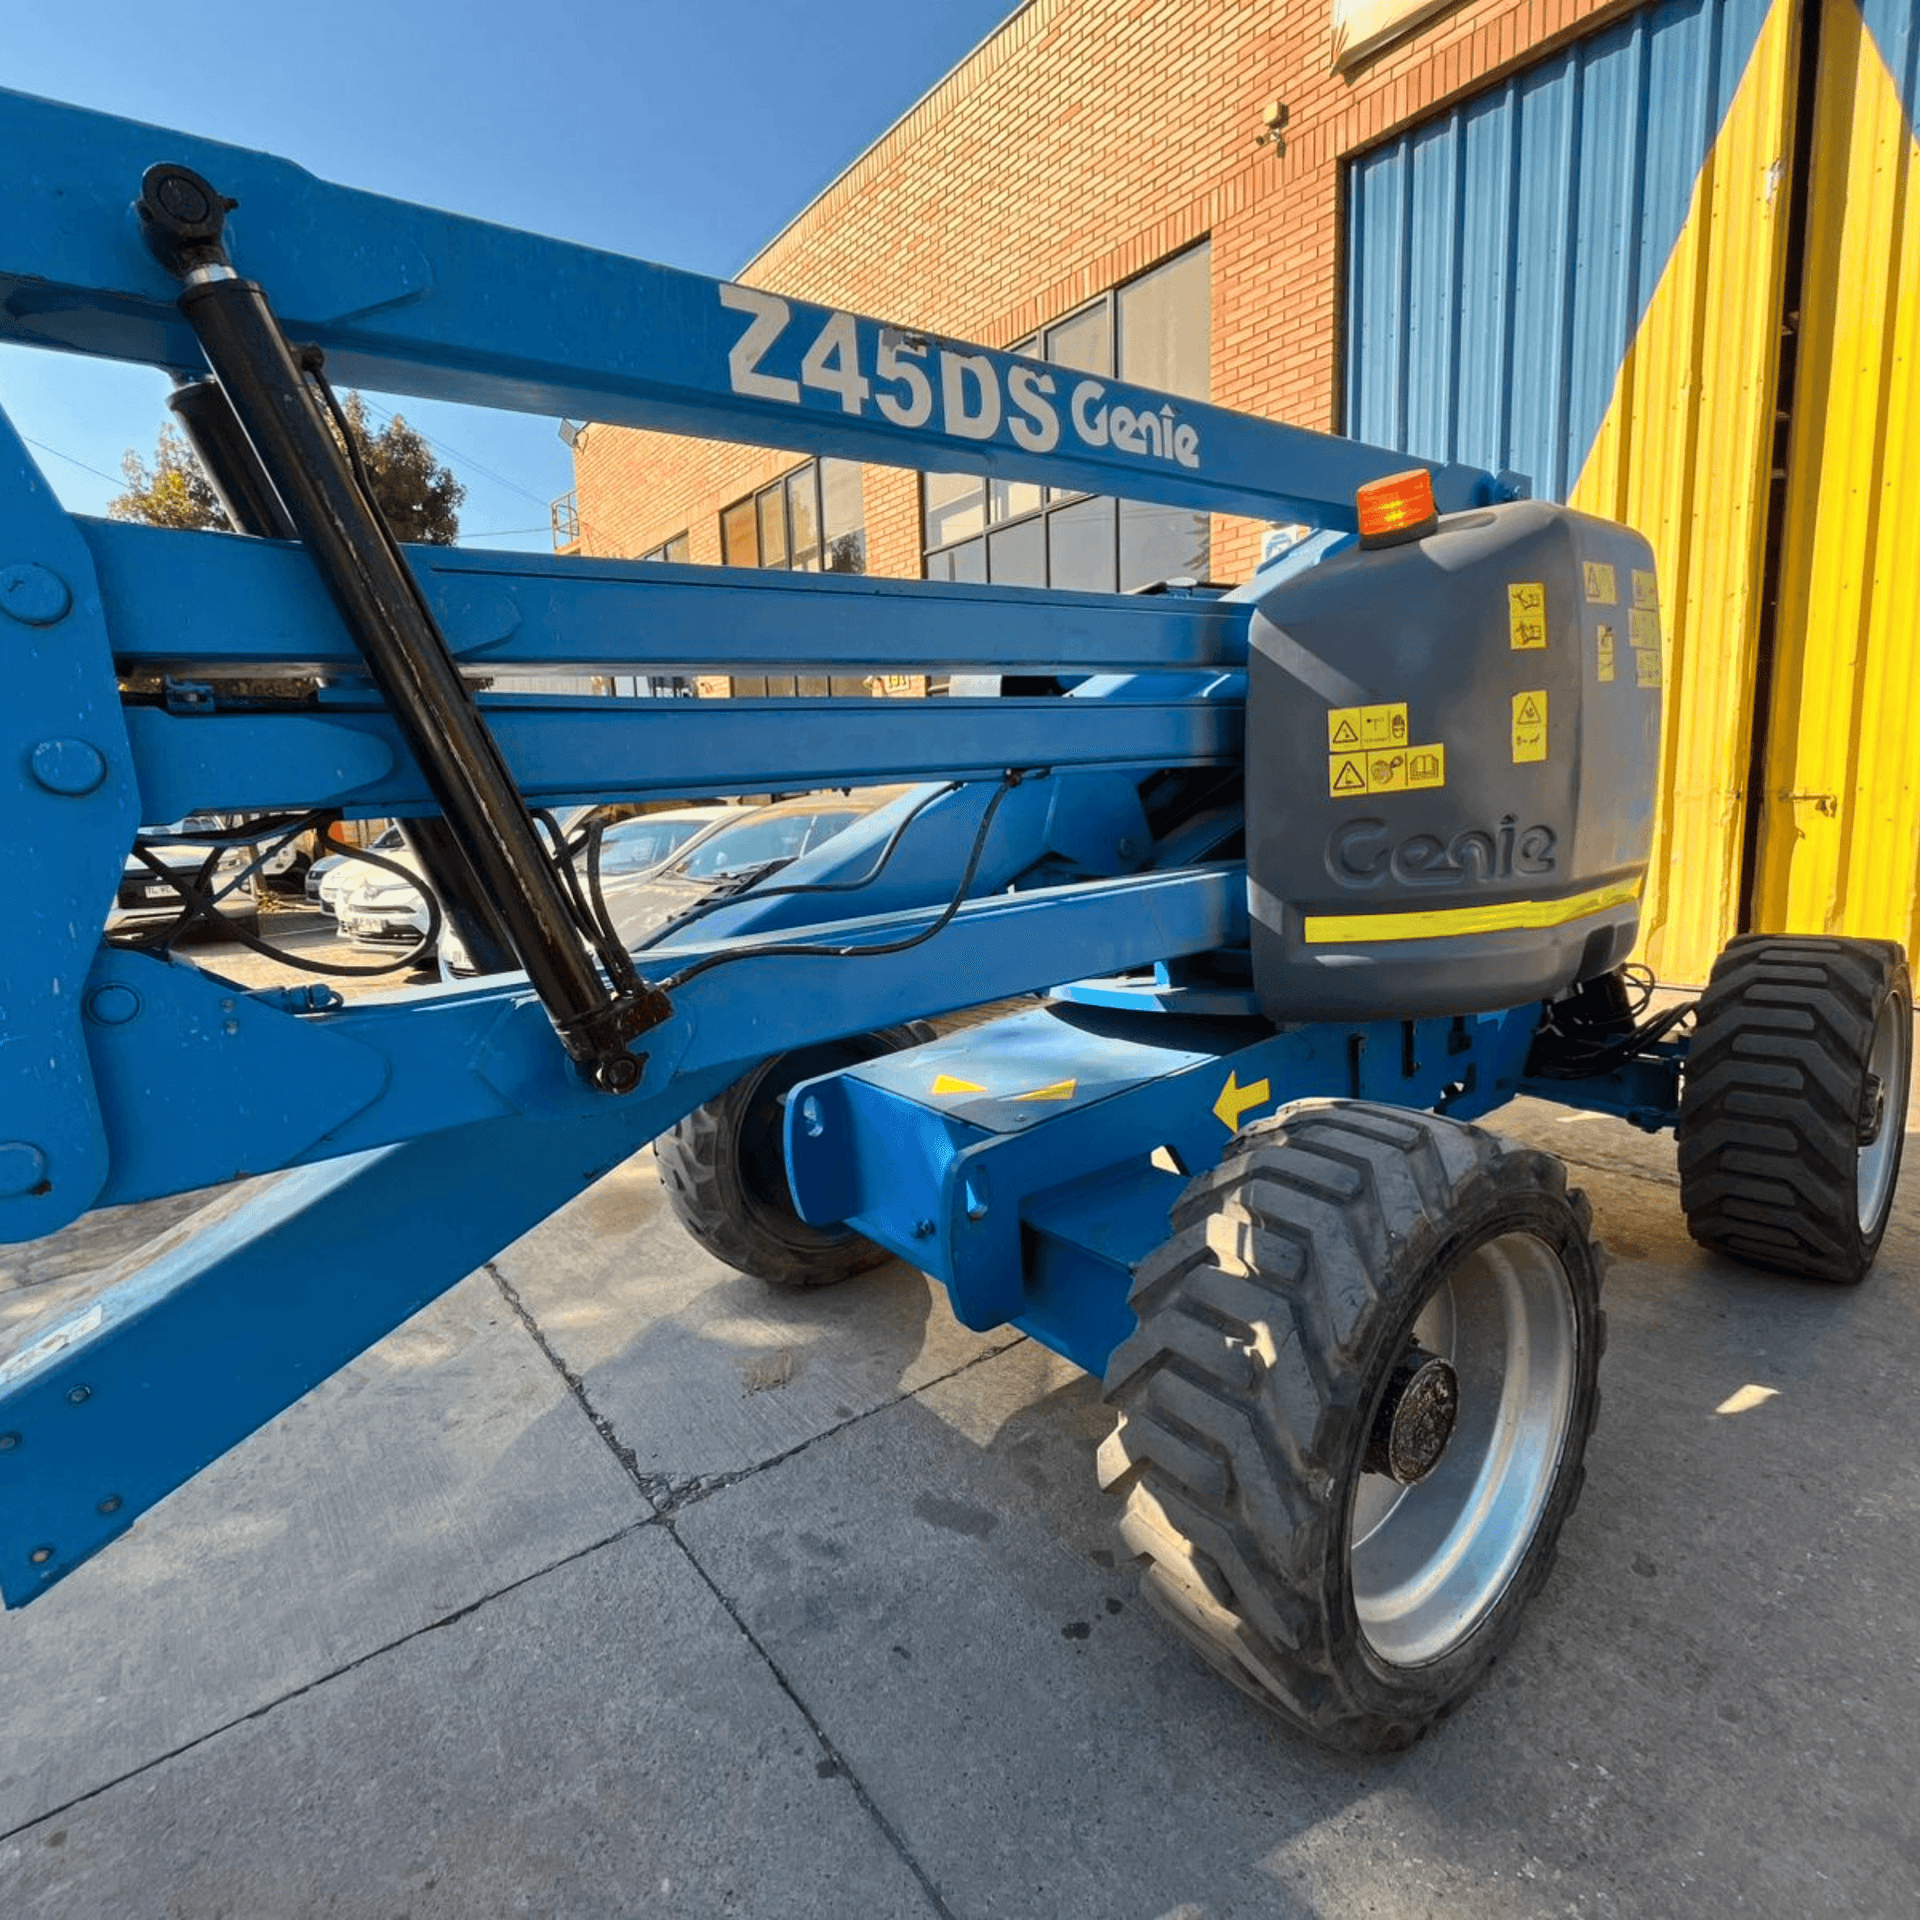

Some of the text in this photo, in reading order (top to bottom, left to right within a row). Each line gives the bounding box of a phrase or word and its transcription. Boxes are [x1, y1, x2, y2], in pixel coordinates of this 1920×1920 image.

[719, 283, 1200, 469] Z45DS Genie
[1325, 813, 1557, 889] Genie
